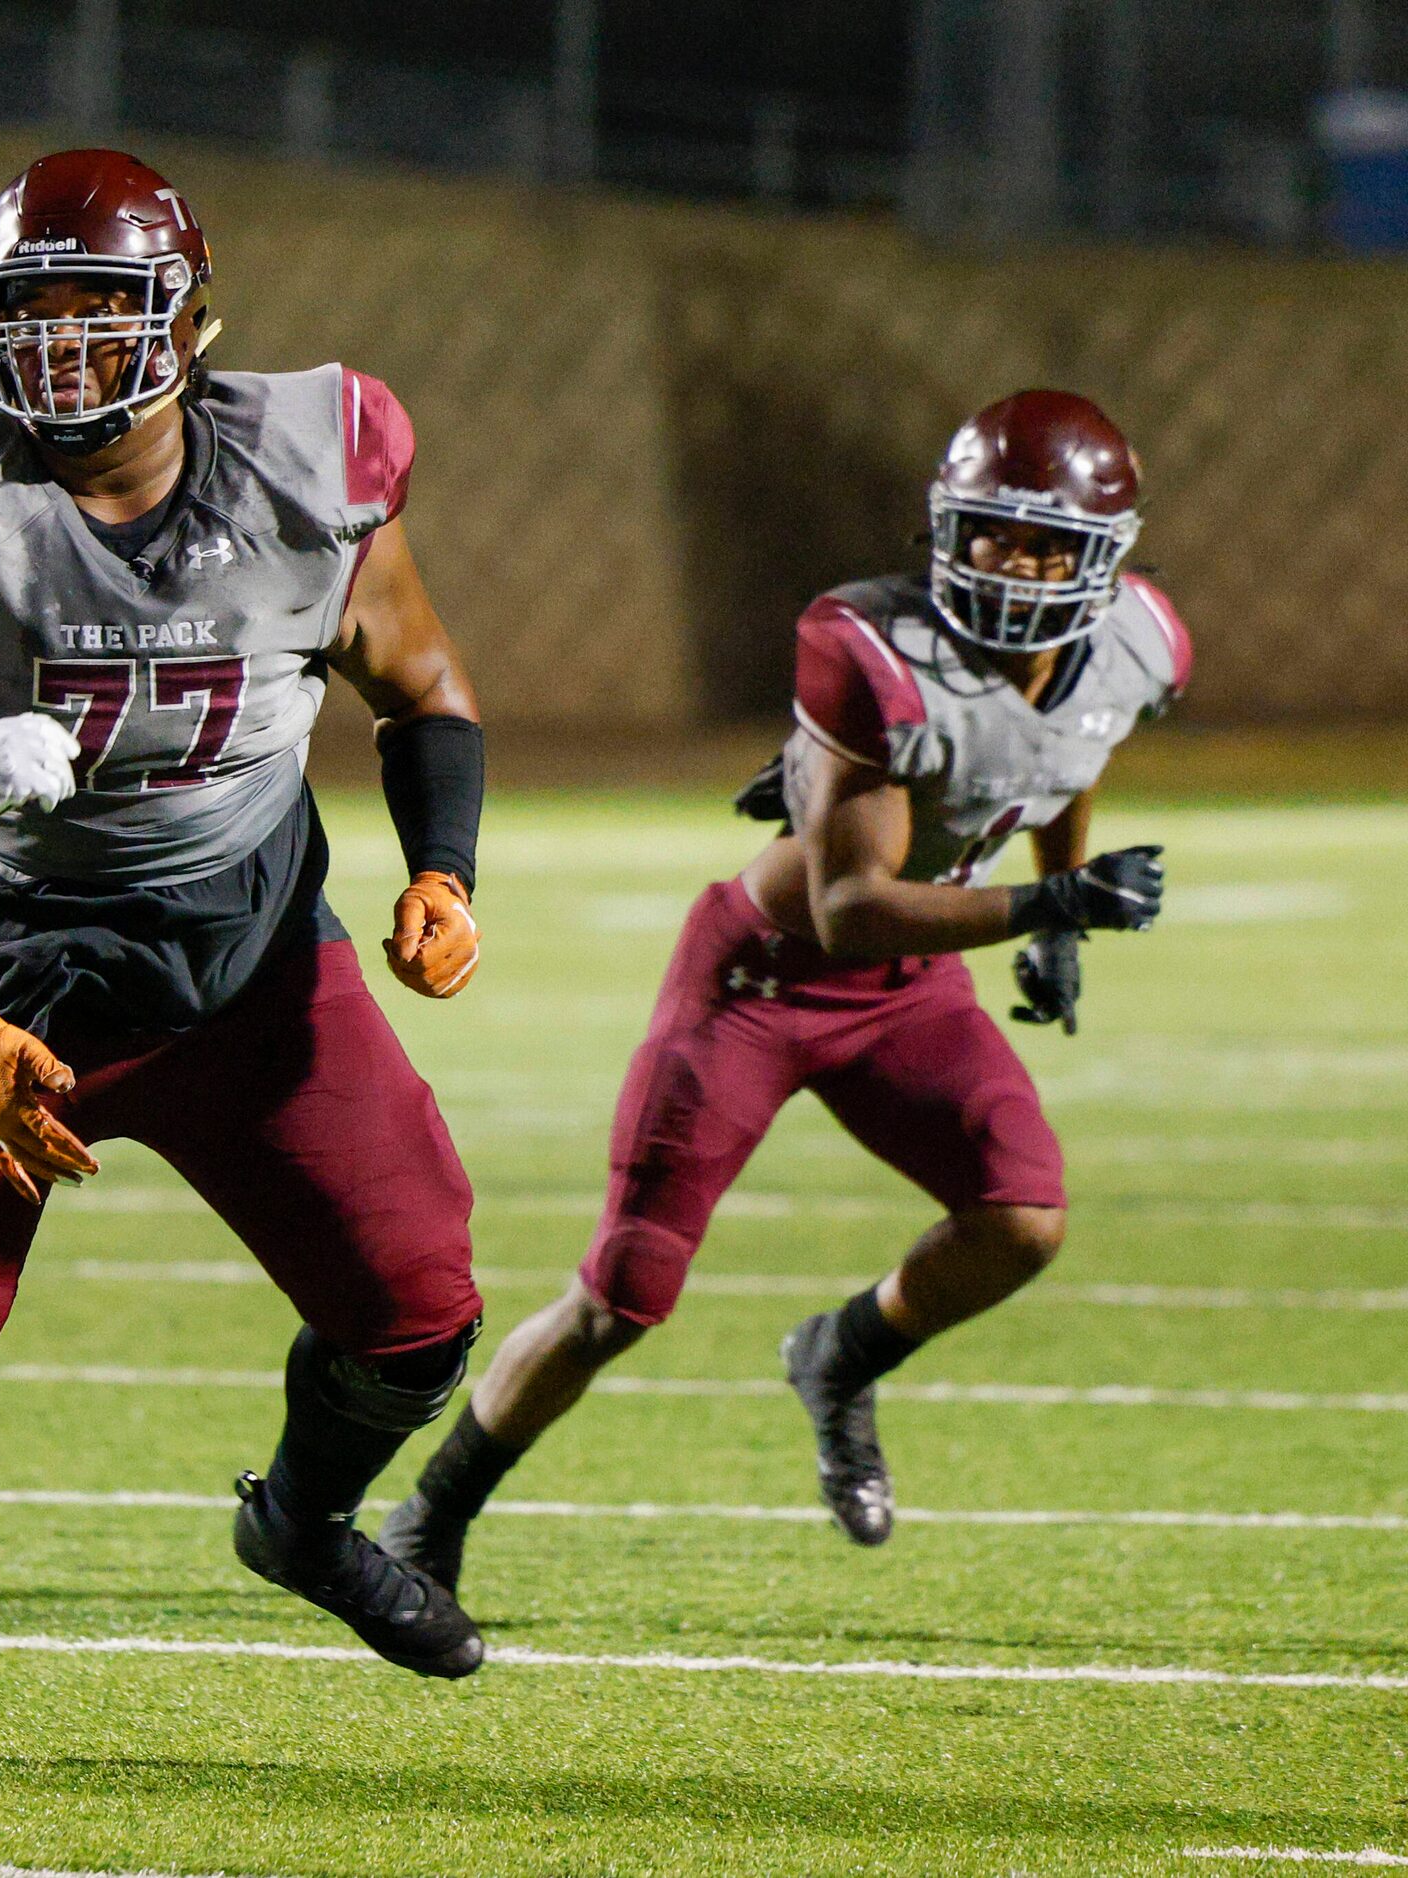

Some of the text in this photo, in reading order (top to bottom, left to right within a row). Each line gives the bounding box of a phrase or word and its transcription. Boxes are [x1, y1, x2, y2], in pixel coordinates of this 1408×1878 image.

[18, 237, 77, 254] Riddell
[60, 620, 218, 649] THE PACK
[32, 653, 251, 793] 77
